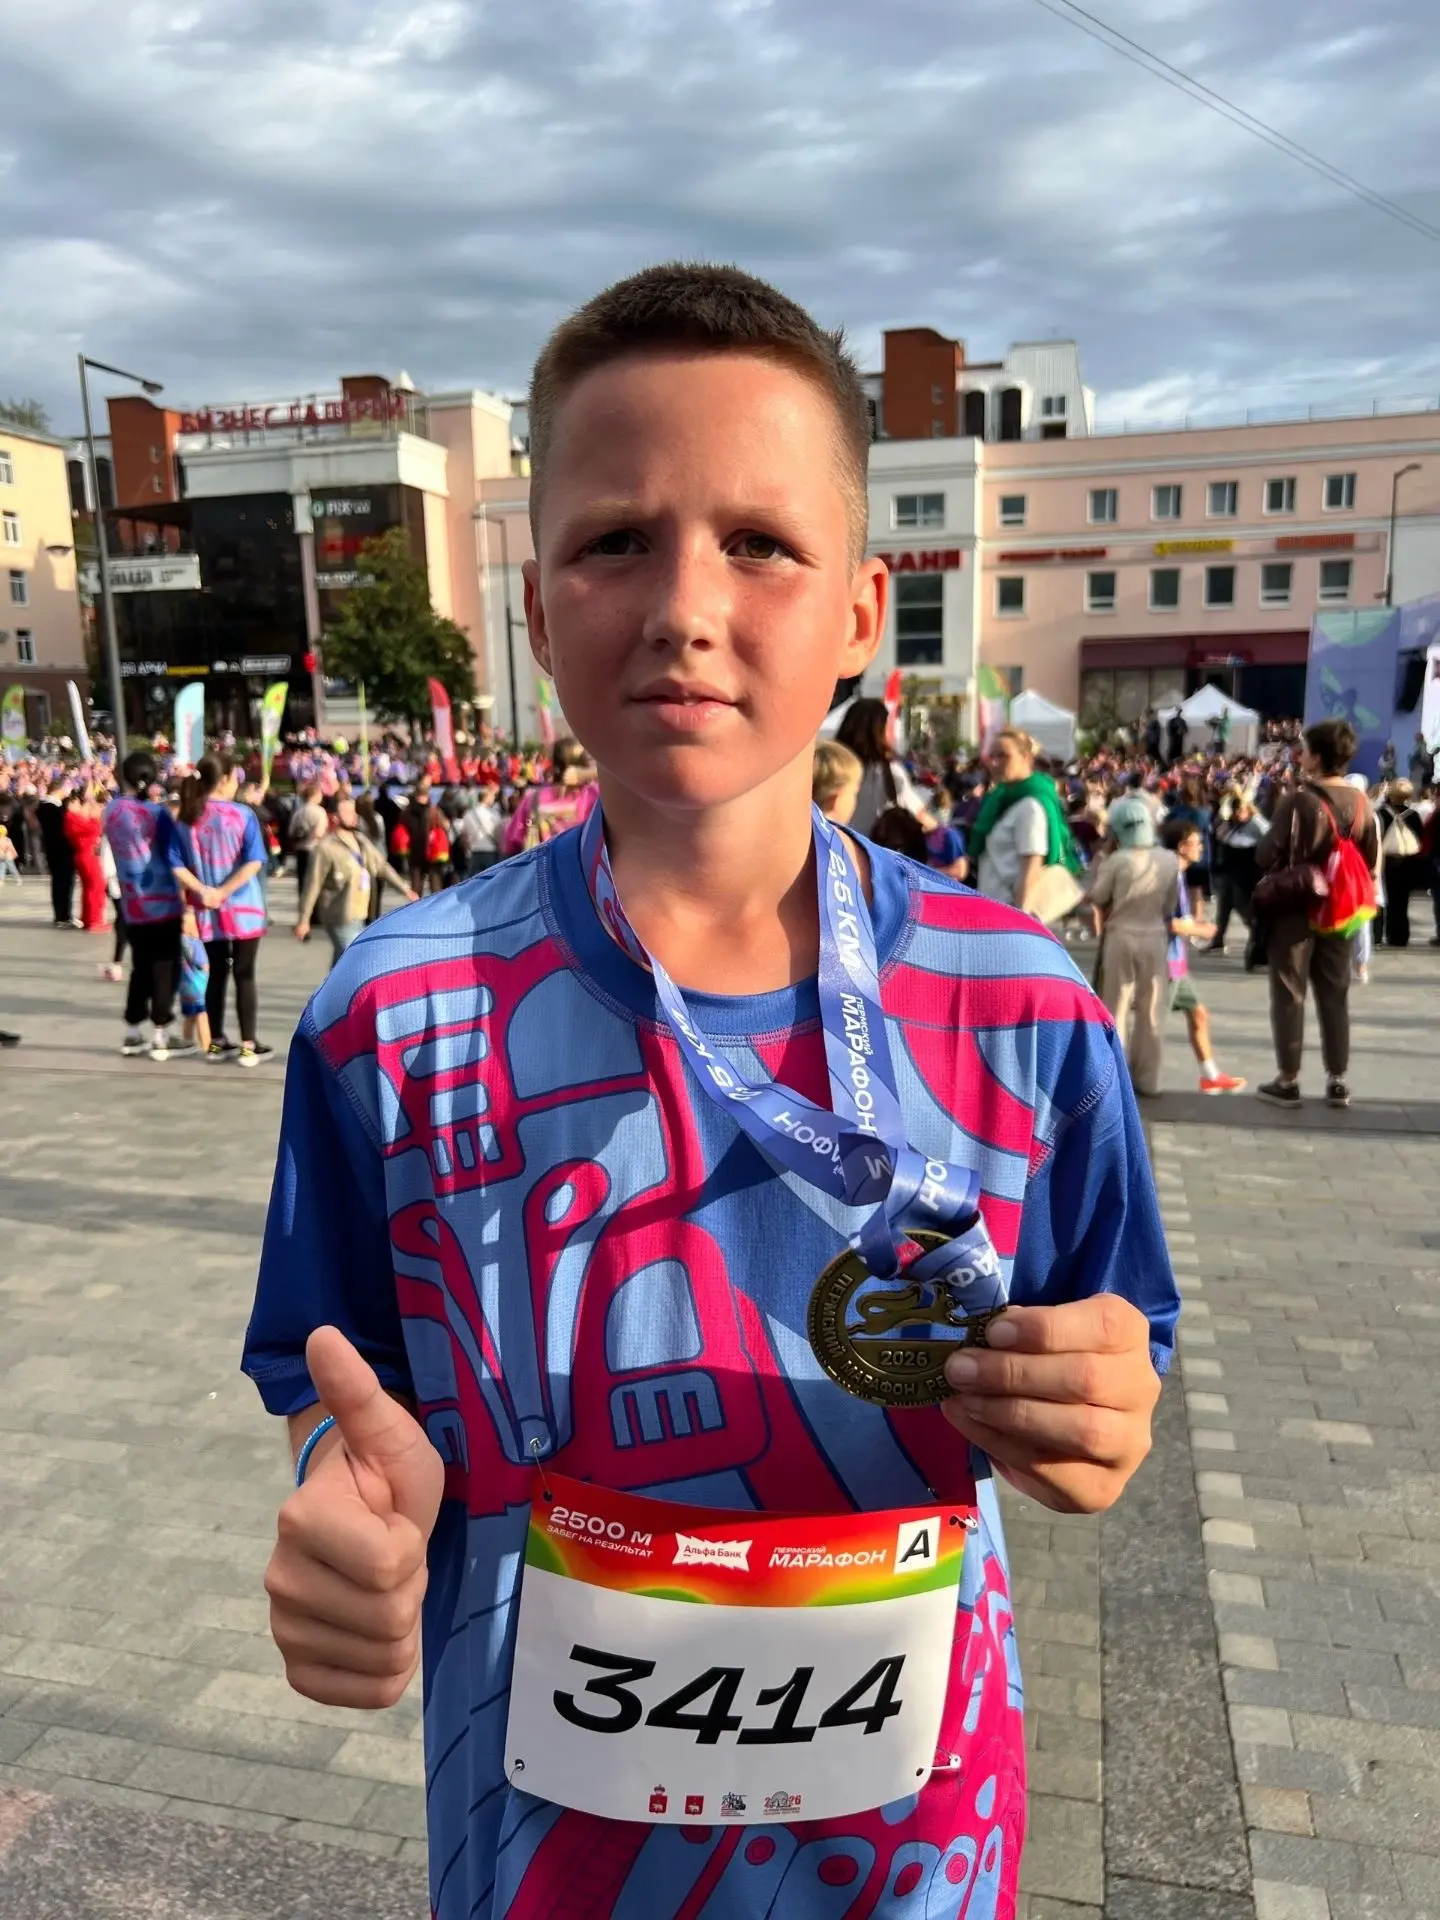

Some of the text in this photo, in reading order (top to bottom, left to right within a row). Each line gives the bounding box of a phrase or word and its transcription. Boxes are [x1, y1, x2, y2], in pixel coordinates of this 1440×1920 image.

[855, 996, 874, 1056] ПЕРМСКИЙ
[840, 992, 877, 1132] МАРАФОН
[822, 1273, 916, 1395] ПЕРМСКИЙ МАРАФОН
[880, 1350, 928, 1367] 2026
[546, 1524, 654, 1558] ЗАБЕГ НА РЕЗУЛЬТАТ
[550, 1506, 653, 1546] 2500 М
[683, 1544, 741, 1558] Альфа Банк
[768, 1548, 888, 1569] МАРАФОН
[773, 1545, 827, 1555] ПЕРМСКИЙ
[553, 1643, 906, 1745] 3414
